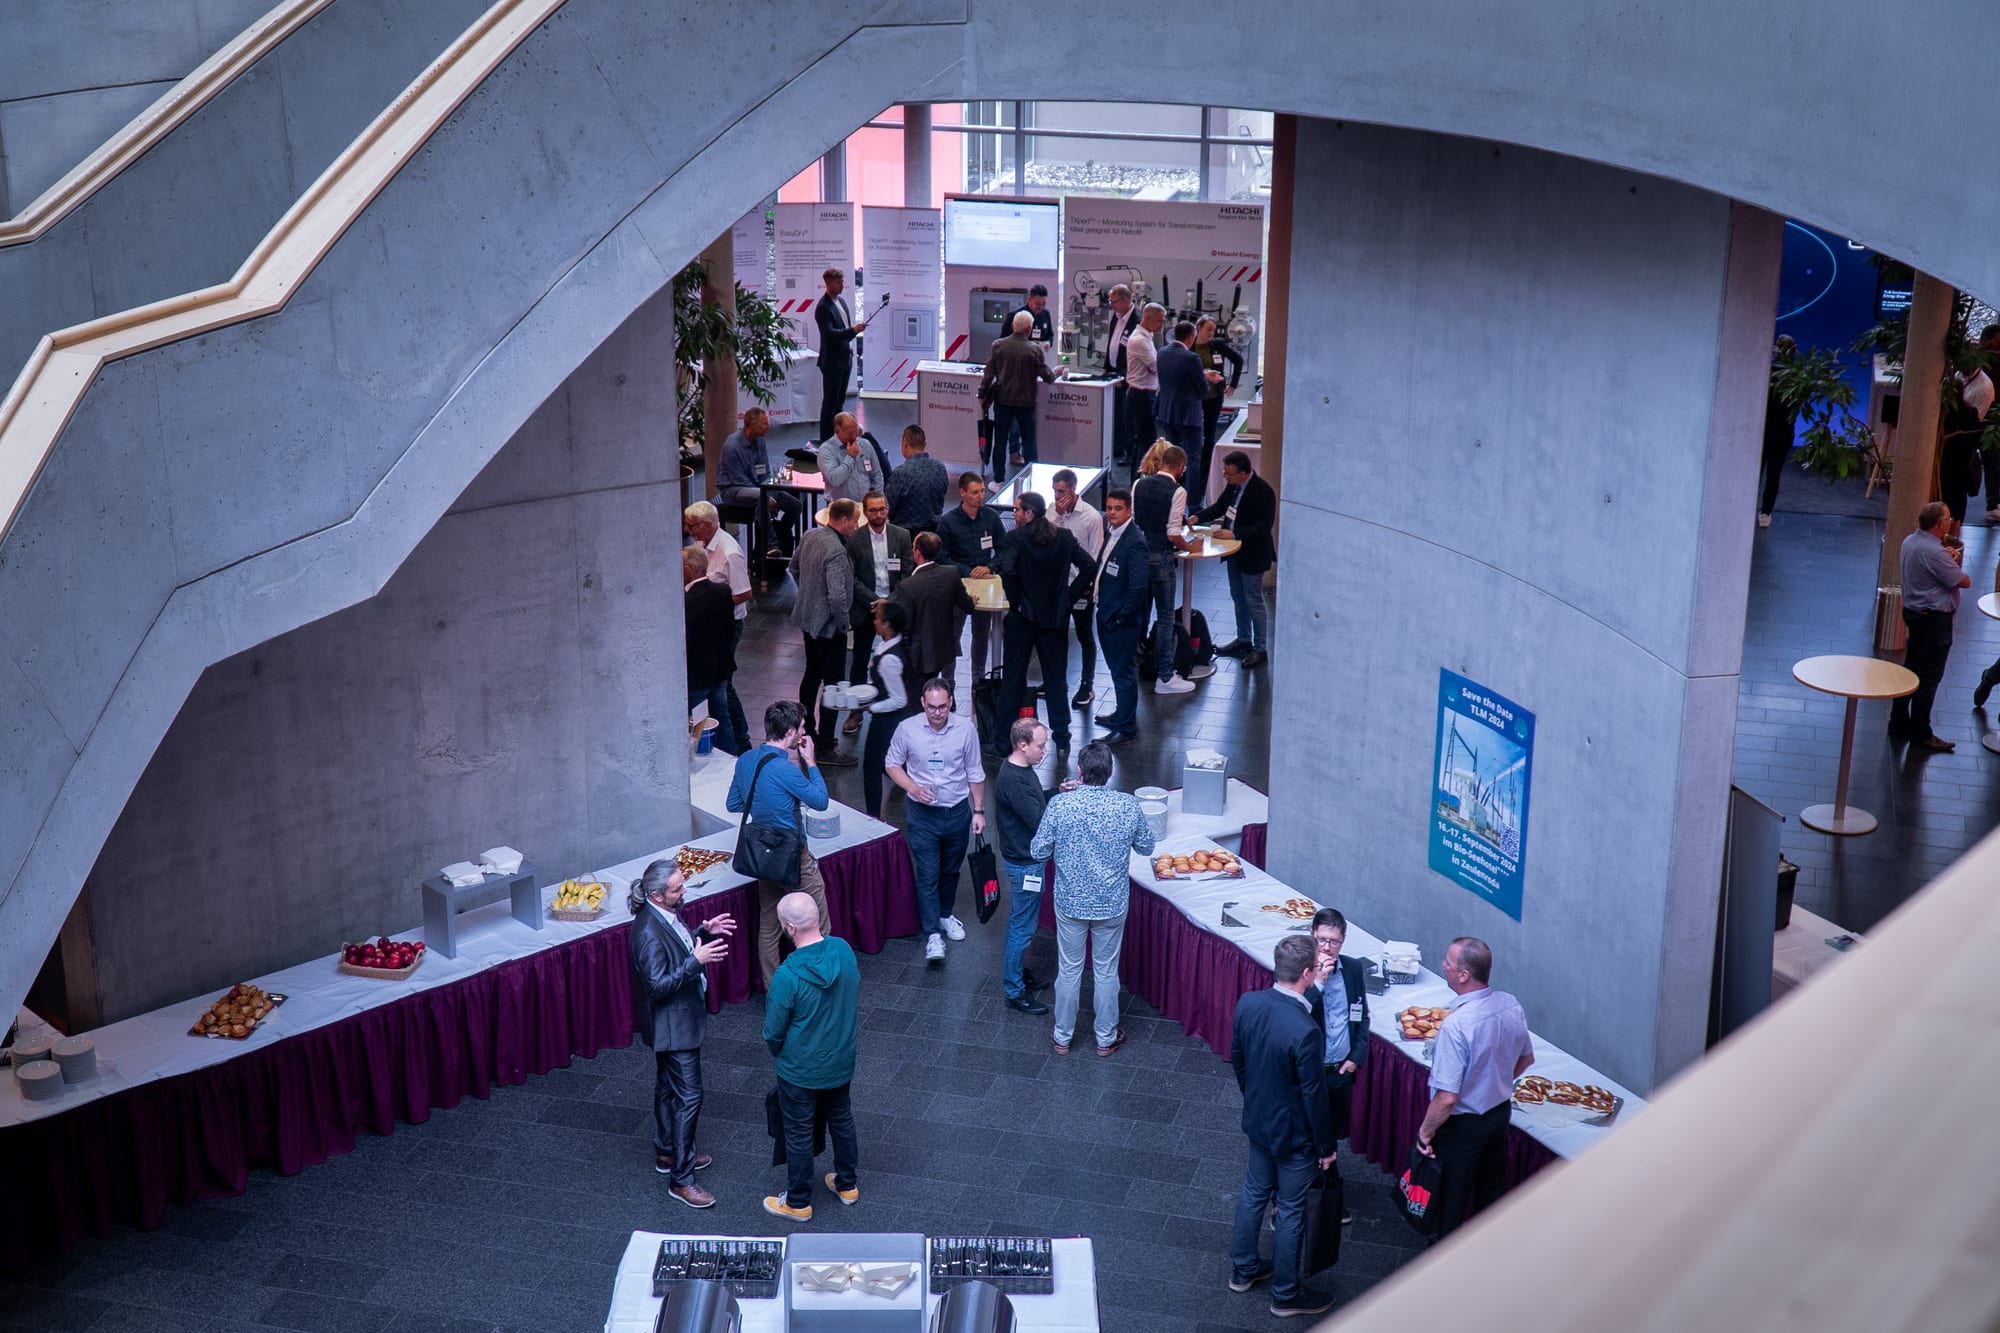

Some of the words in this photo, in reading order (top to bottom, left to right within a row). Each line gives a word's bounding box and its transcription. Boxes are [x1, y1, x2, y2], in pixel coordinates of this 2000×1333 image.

[1220, 206, 1260, 216] HITACHI
[1102, 218, 1133, 227] Monitoring
[1134, 220, 1156, 228] System
[1168, 222, 1216, 231] Transformatoren
[1240, 251, 1260, 260] Energy
[933, 381, 969, 390] HITACHI
[1050, 393, 1088, 401] HITACHI
[954, 405, 974, 413] Energy
[1462, 687, 1481, 703] Save
[1483, 695, 1496, 710] the
[1496, 704, 1514, 721] Date
[1471, 704, 1487, 720] TLM
[1488, 713, 1505, 730] 2024
[1442, 835, 1453, 849] im
[1462, 833, 1500, 862] September
[1500, 856, 1517, 873] 2024
[1451, 854, 1460, 866] in
[1461, 859, 1500, 890] Zeulenroda
